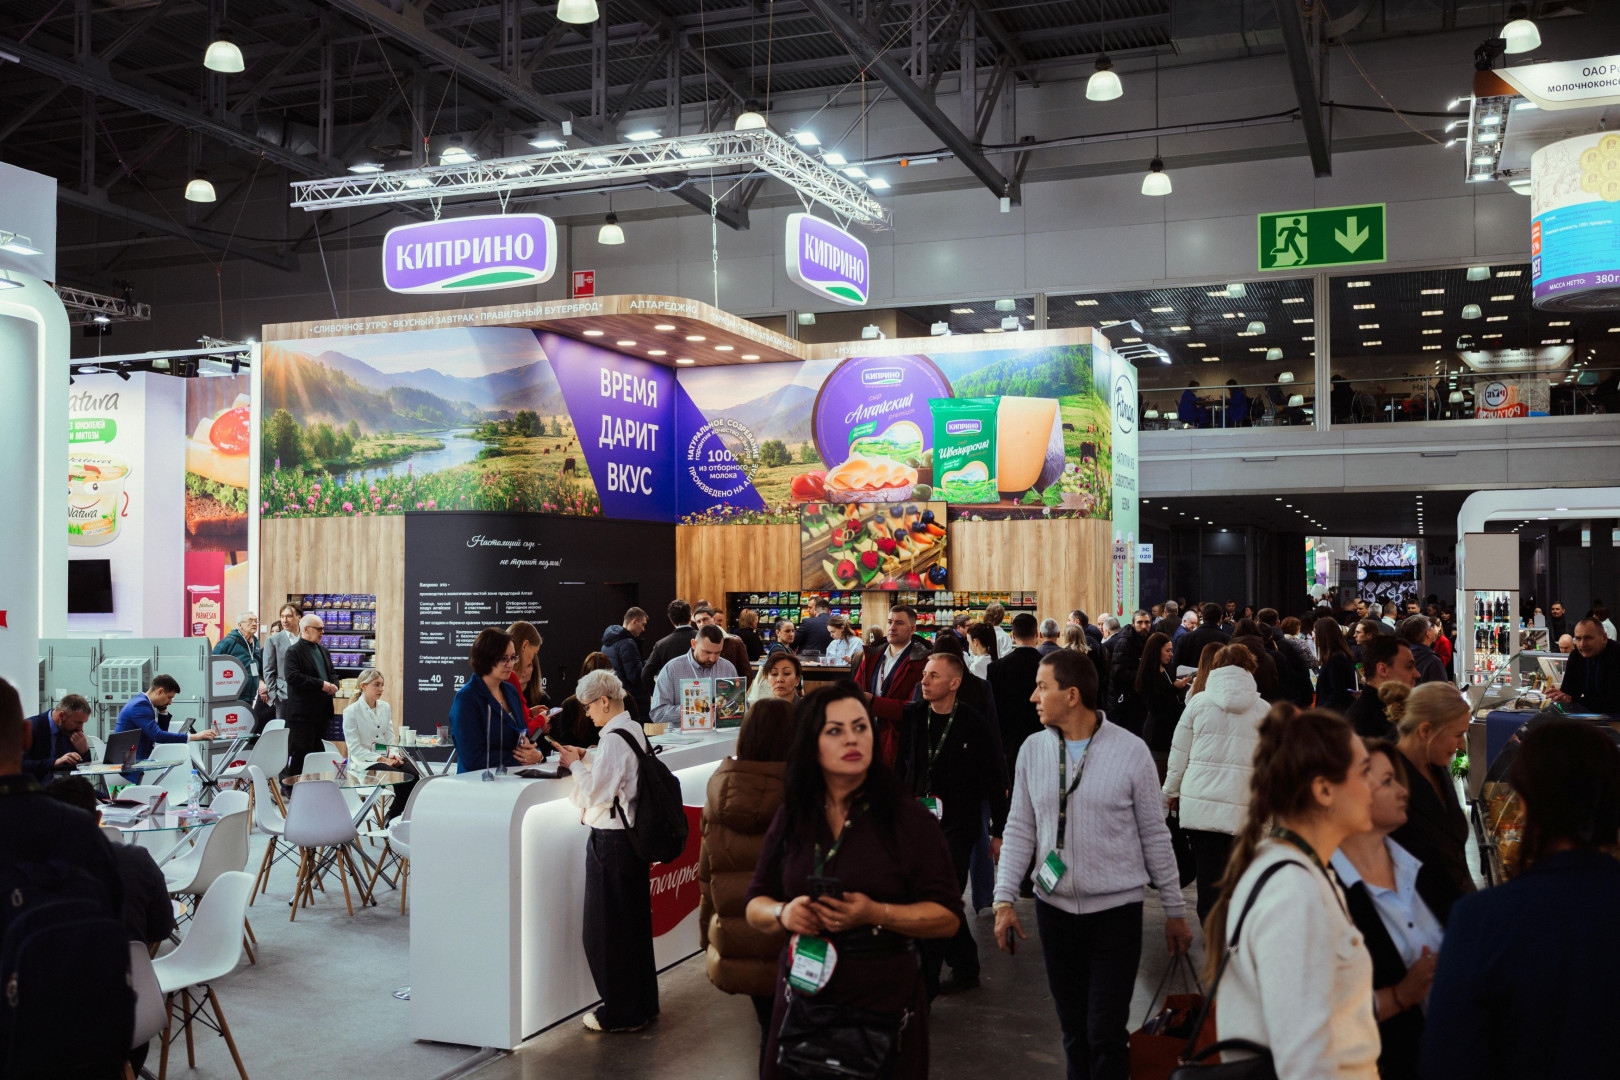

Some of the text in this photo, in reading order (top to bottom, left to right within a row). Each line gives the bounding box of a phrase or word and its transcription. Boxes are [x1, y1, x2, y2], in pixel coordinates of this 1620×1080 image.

[1582, 66, 1606, 77] ОАО
[397, 232, 535, 271] КИПРИНО
[805, 232, 864, 284] КИПРИНО
[1596, 274, 1614, 284] 380
[630, 300, 698, 314] АЛТАРЕДЖИО
[314, 302, 598, 334] СЛИВОЧНОЕ УТРО ВКУСНЫЙ ЗАВТРАК ПРАВИЛЬНЫЙ БУТЕРБРОД
[865, 372, 900, 380] КИПРИНО
[600, 367, 658, 408] ВРЕМЯ
[68, 390, 120, 412] atura
[845, 392, 914, 424] Алтайский
[889, 408, 915, 420] premium
[598, 414, 660, 452] ДАРИТ
[688, 418, 759, 461] НАТУРАЛЬНОЕ СОЗРЕВАНИЕ
[708, 449, 739, 462] 100%
[938, 439, 990, 459] Швейцарский
[708, 464, 748, 474] отборного
[608, 462, 653, 496] ВКУС
[689, 464, 758, 498] ПРОИЗВЕДЕНО НА АЛТАЕ
[466, 534, 535, 550] Настоящий сыр
[510, 558, 537, 568] терпит
[431, 674, 441, 683] 40
[454, 675, 465, 683] 78
